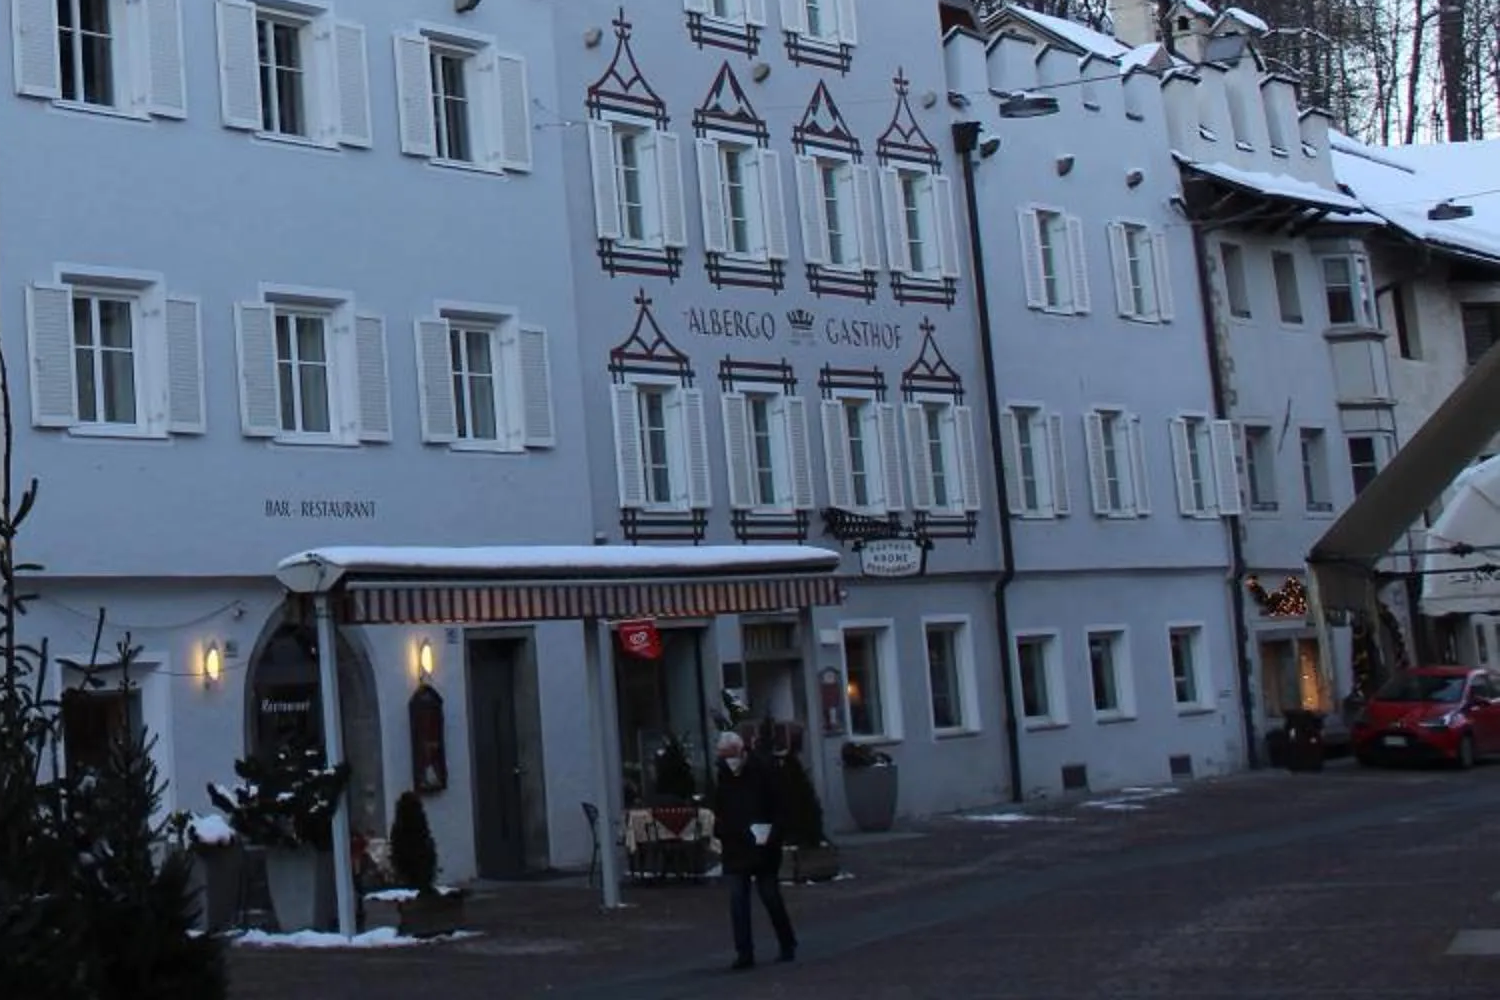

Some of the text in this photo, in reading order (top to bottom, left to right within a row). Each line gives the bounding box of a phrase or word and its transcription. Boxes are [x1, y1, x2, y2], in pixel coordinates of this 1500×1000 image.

[688, 307, 776, 342] ALBERGO
[825, 318, 903, 351] GASTHOF
[264, 500, 377, 519] BAR RESTAURANT
[873, 552, 908, 563] KRONE
